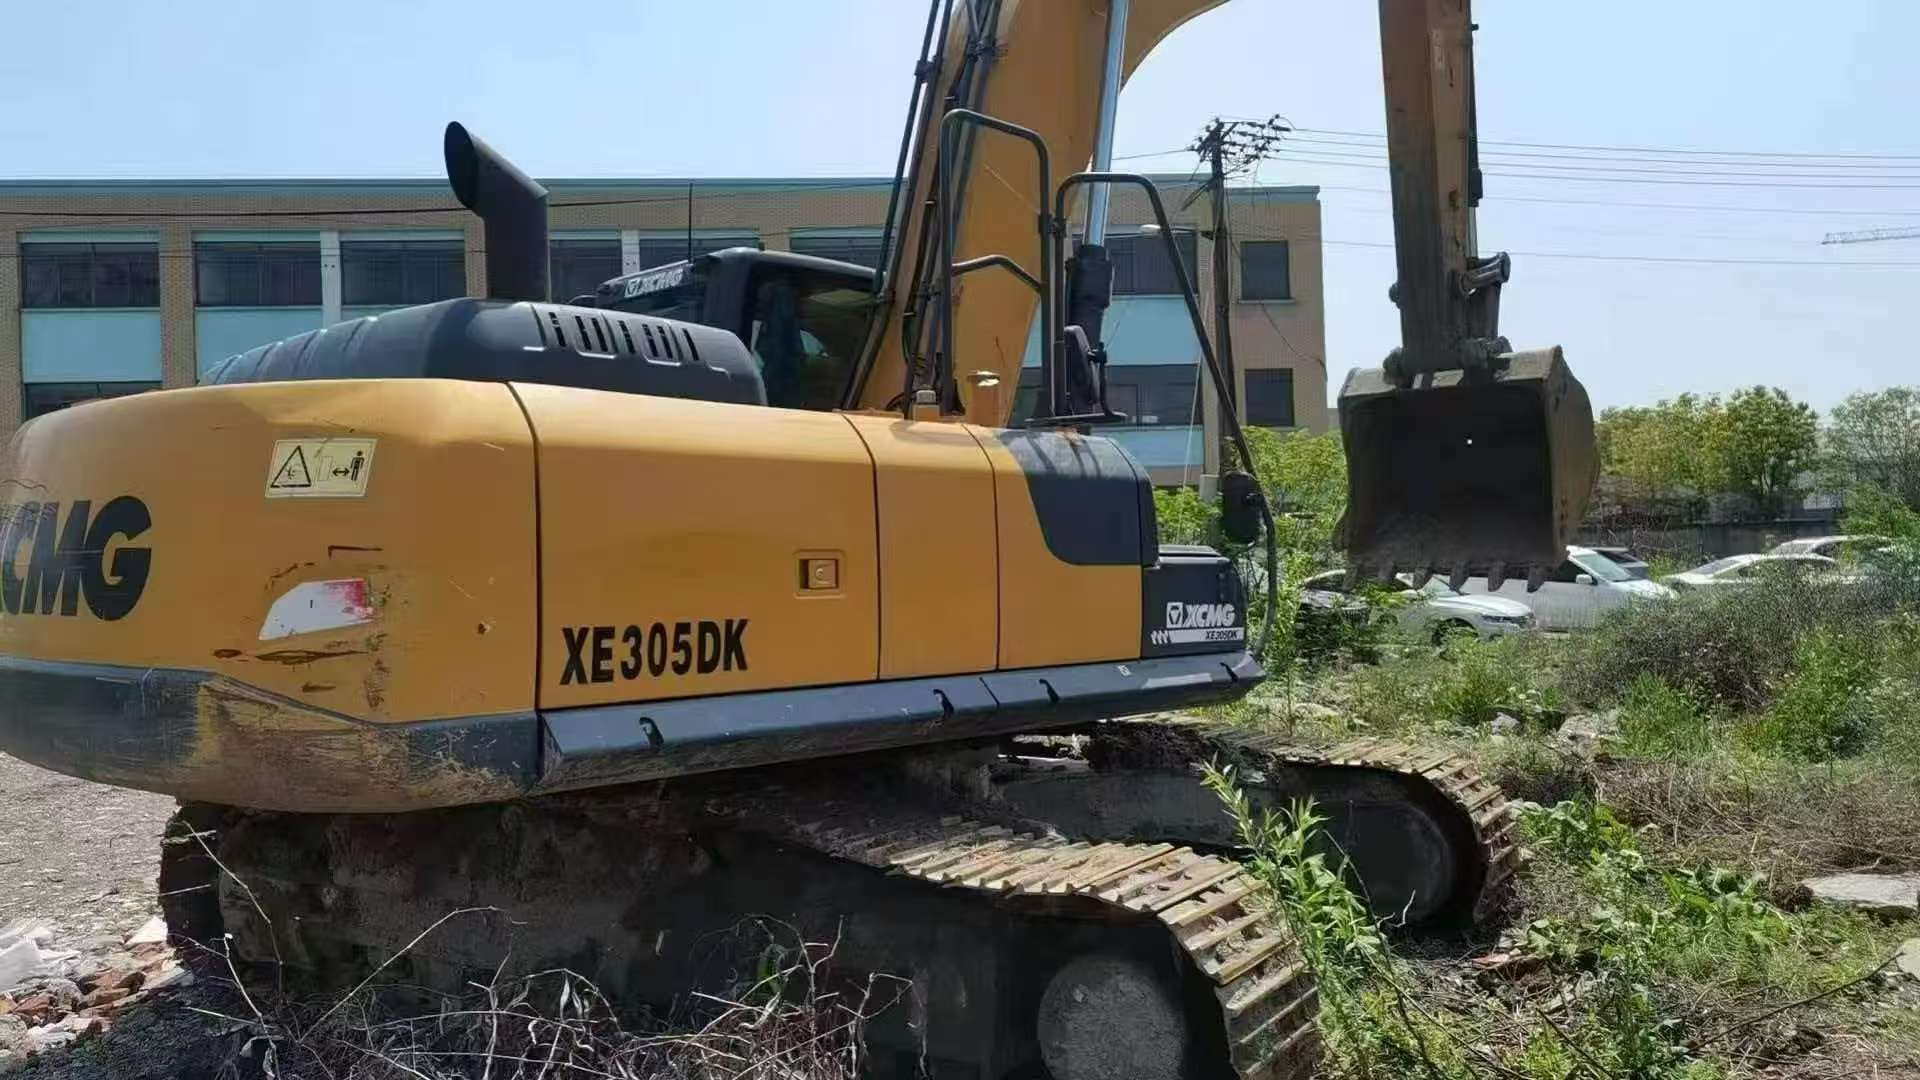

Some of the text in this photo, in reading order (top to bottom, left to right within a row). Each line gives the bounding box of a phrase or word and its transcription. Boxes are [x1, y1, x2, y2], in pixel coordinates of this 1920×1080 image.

[0, 495, 152, 621] CMG
[1183, 603, 1235, 627] XCMG
[559, 618, 749, 685] XE305DK
